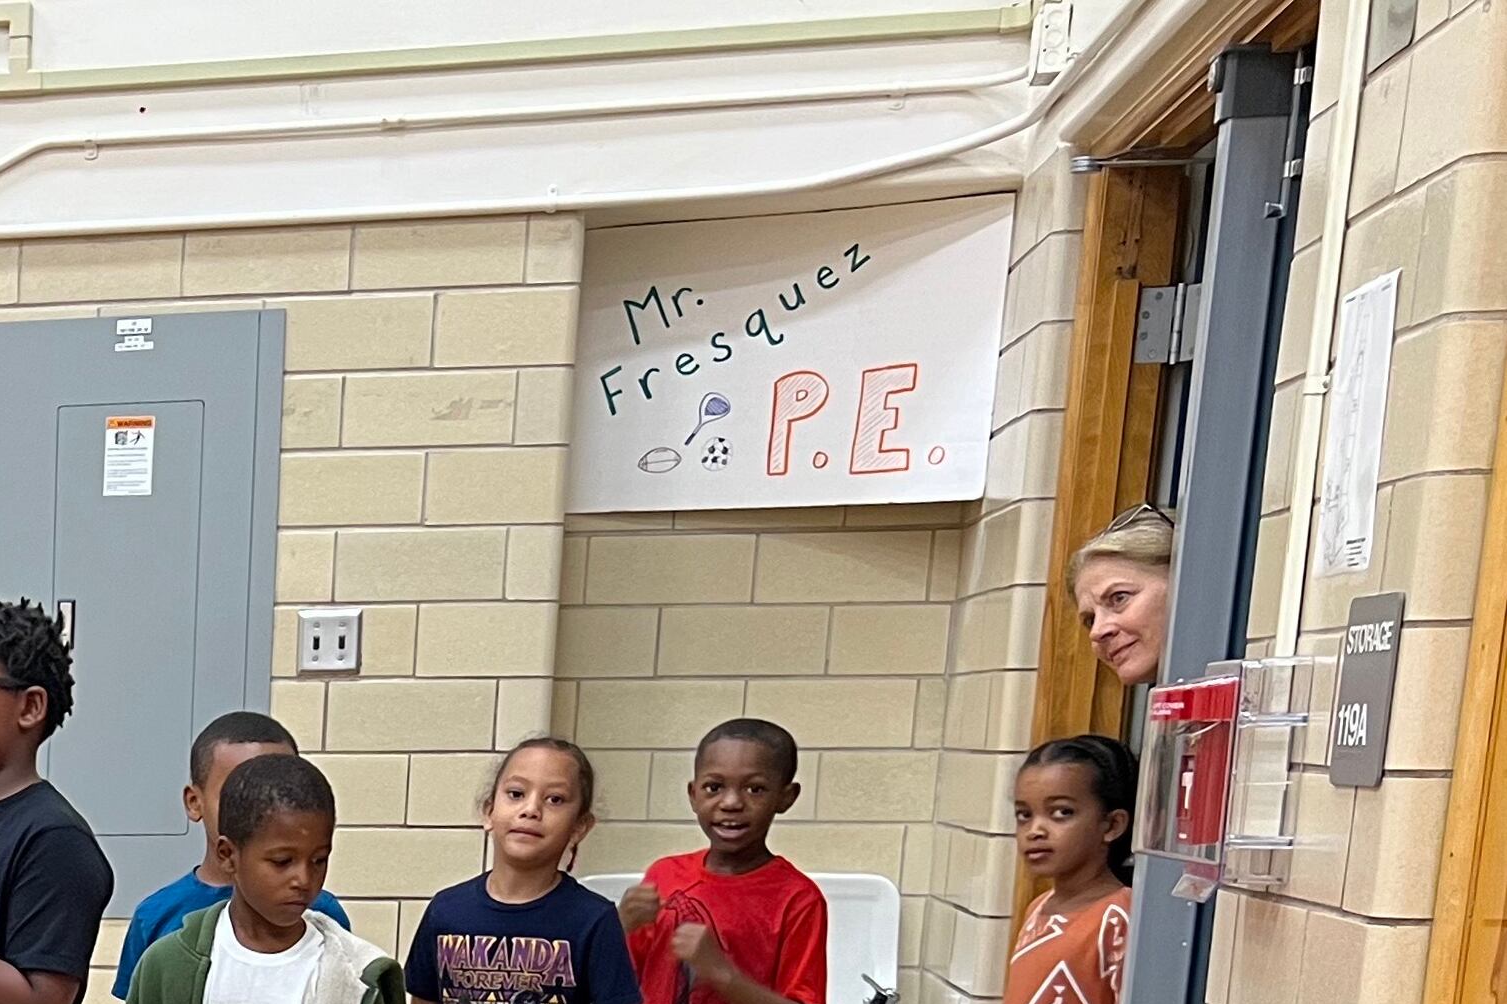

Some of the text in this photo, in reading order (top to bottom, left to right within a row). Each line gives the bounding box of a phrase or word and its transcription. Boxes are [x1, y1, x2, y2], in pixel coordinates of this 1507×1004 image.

[600, 243, 871, 416] Fresquez
[623, 285, 704, 345] Mr.
[767, 363, 946, 476] P.E.
[1346, 621, 1394, 655] STORAGE
[1336, 703, 1368, 747] 119A
[437, 934, 577, 988] WAKANDA
[451, 968, 544, 992] FOREVER
